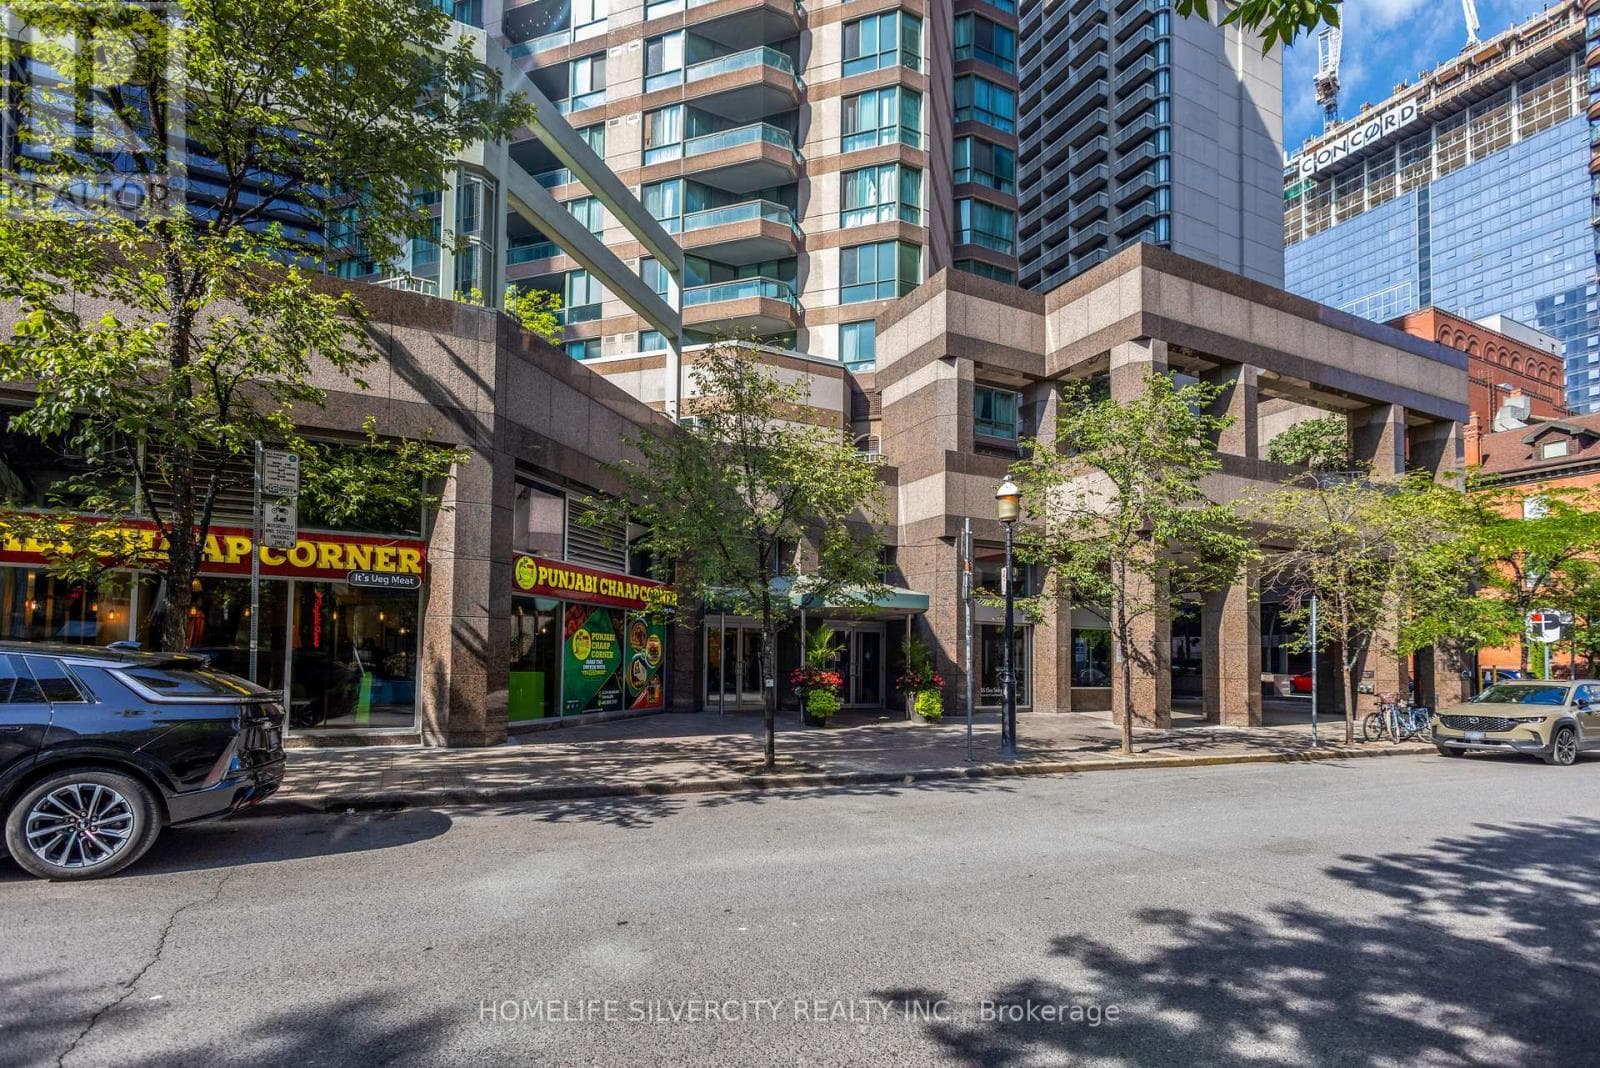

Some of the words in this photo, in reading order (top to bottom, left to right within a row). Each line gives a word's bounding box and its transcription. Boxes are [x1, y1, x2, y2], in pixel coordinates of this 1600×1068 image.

[1301, 105, 1415, 173] CONCORD
[259, 540, 422, 574] CORNER
[355, 573, 370, 582] It's
[391, 576, 414, 585] Meat
[538, 566, 598, 593] PUNJABI
[600, 578, 640, 600] CHAAP
[592, 632, 616, 641] PUNJABI
[592, 642, 611, 650] CHAAP
[591, 651, 614, 659] CORNER
